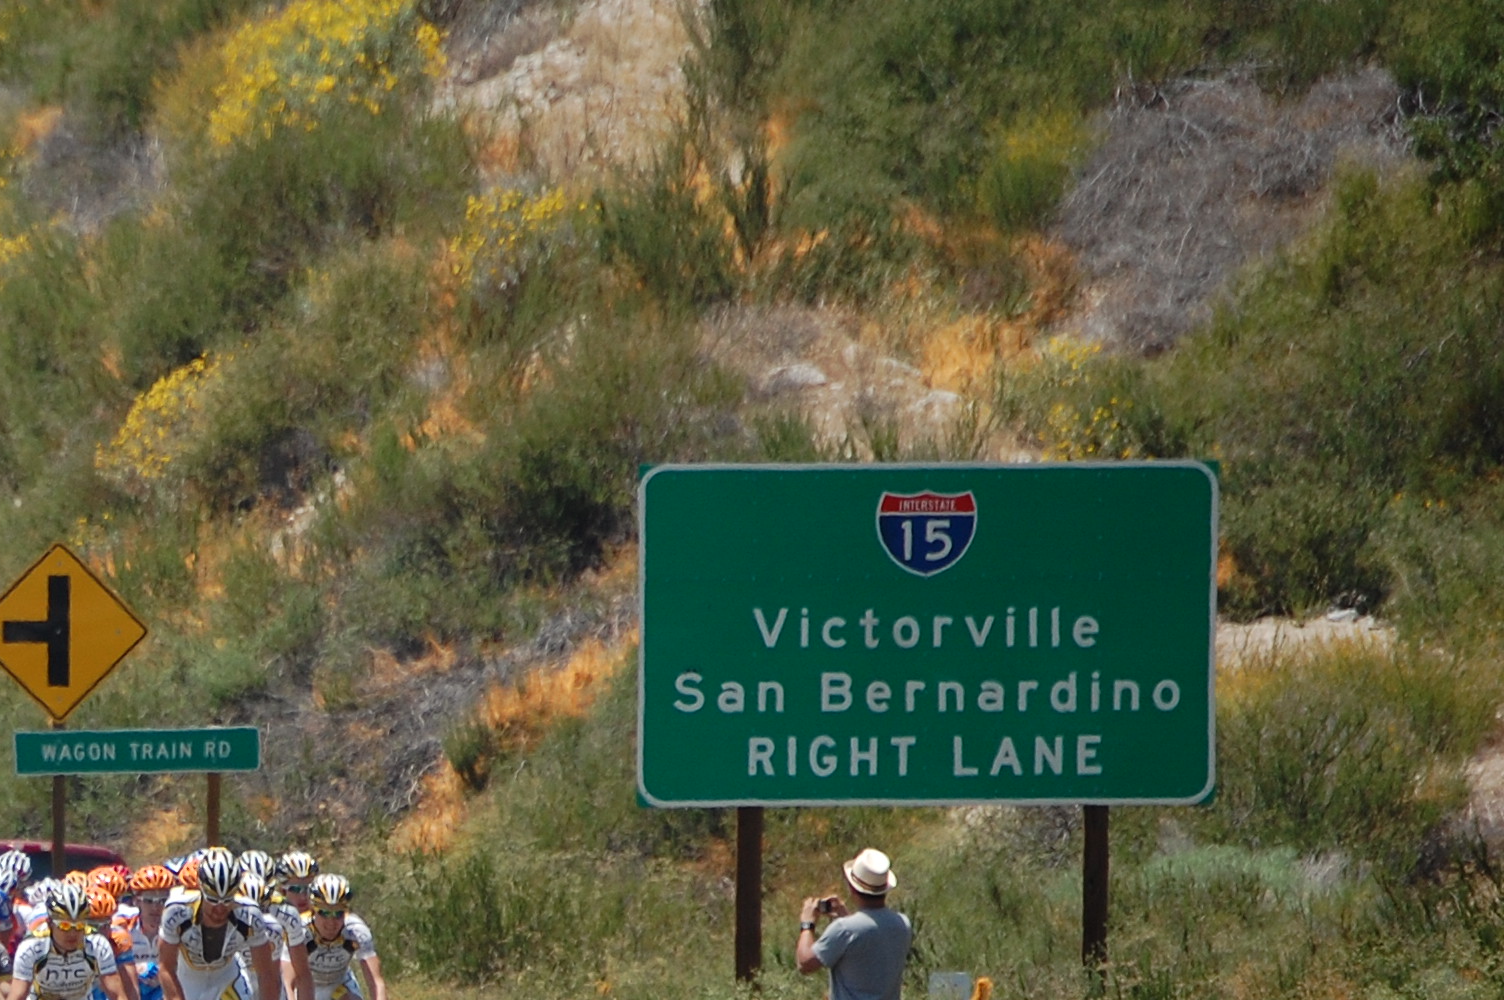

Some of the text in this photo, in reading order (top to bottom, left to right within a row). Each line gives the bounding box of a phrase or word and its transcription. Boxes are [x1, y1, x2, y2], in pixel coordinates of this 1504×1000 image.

[899, 499, 956, 512] INTERSTATE
[901, 520, 953, 561] 15
[753, 606, 1101, 648] Victorville
[673, 671, 1181, 713] San Bernardino
[42, 741, 231, 762] WAGON TRAIN RD
[748, 734, 1104, 777] RIGHT LANE
